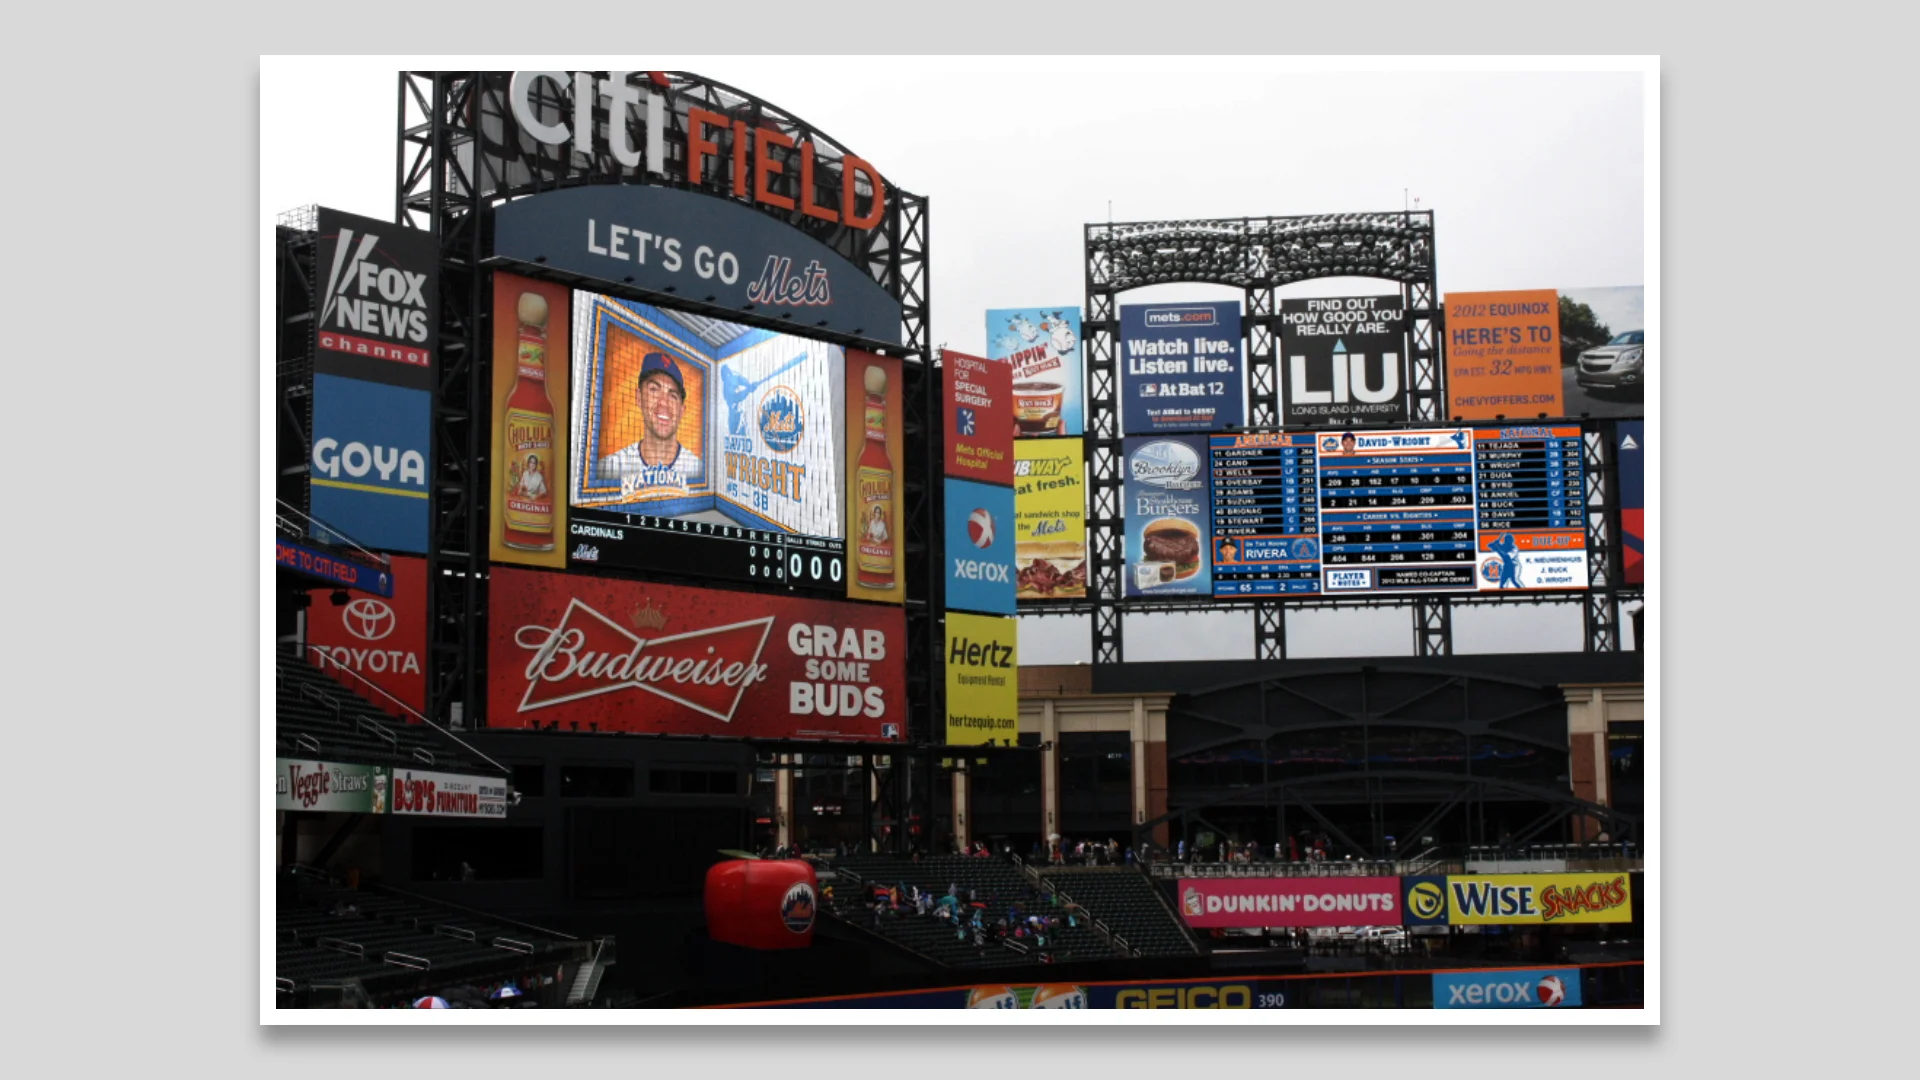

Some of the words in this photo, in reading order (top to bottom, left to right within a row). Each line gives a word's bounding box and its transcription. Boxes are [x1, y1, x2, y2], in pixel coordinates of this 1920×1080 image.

[509, 71, 664, 174] citi
[688, 106, 885, 231] FIELD
[588, 218, 683, 272] LET'S
[694, 245, 740, 285] GO
[747, 254, 834, 307] Mets
[358, 261, 427, 309] FOX
[1308, 300, 1341, 311] FIND
[1348, 298, 1378, 310] OUT
[1453, 304, 1486, 317] 2012
[1489, 303, 1550, 316] EQUINOX
[337, 295, 428, 343] NEWS
[1149, 311, 1212, 323] mets.com
[1282, 312, 1318, 325] HOW
[1323, 311, 1367, 323] GOOD
[1371, 309, 1404, 322] YOU
[1296, 323, 1353, 336] REALLY
[1356, 321, 1391, 334] ARE.
[1452, 327, 1522, 345] HERE'S
[1526, 325, 1553, 343] TO
[321, 336, 430, 365] channel
[1128, 339, 1189, 356] Watch
[1193, 336, 1235, 355] live.
[1453, 347, 1485, 358] Going
[1487, 346, 1504, 355] the
[1506, 345, 1552, 355] distance
[954, 358, 988, 374] HOSPITAL
[1129, 356, 1188, 375] Listen
[1193, 354, 1234, 373] live.
[1489, 359, 1514, 376] 32
[954, 369, 970, 381] FOR
[955, 380, 988, 396] SPECIAL
[1158, 383, 1177, 397] At
[1179, 382, 1205, 396] Bat
[1208, 382, 1224, 395] 12
[955, 391, 992, 408] SURGERY
[1455, 394, 1555, 407] CHEVYOFFERS.COM
[1291, 406, 1317, 415] LONG
[1319, 405, 1349, 414] ISLAND
[1350, 404, 1400, 413] UNIVERSITY
[1234, 435, 1293, 448] AMERICAN
[1500, 427, 1556, 440] NATIONAL
[723, 436, 753, 454] DAVID
[956, 443, 975, 456] Mets
[976, 447, 1004, 460] Official
[312, 436, 425, 485] GOYA
[956, 455, 988, 469] Hospital
[724, 450, 807, 503] WRIGHT
[1134, 461, 1193, 479] Brooklyn
[1037, 476, 1080, 491] fresh.
[510, 501, 549, 513] ORIGINAL
[753, 491, 769, 511] 3B
[1136, 497, 1200, 516] Burgers
[1024, 510, 1059, 519] sandwich
[1062, 511, 1080, 519] shop
[626, 514, 631, 524] 1
[640, 515, 647, 526] 2
[653, 517, 660, 528] 3
[668, 521, 675, 530] 4
[682, 521, 689, 532] 5
[696, 523, 702, 533] 6
[710, 524, 716, 534] 7
[723, 527, 729, 537] 8
[736, 528, 743, 538] 9
[750, 531, 757, 541] R
[763, 533, 771, 543] H
[777, 535, 783, 544] E
[570, 524, 624, 540] CARDINALS
[749, 545, 757, 558] 0
[762, 547, 770, 560] 0
[776, 549, 783, 561] 0
[789, 553, 803, 578] 0
[810, 556, 823, 580] 0
[829, 558, 842, 583] 0
[1246, 549, 1288, 559] RIVERA
[299, 551, 313, 570] TO
[314, 557, 331, 575] CITI
[333, 562, 357, 583] FIELD
[749, 563, 757, 577] 0
[762, 566, 770, 578] 0
[776, 567, 783, 579] 0
[954, 558, 1009, 583] xerox
[1333, 572, 1365, 580] PLAYER
[1240, 583, 1252, 592] 65
[1280, 583, 1286, 591] 2
[1312, 582, 1319, 591] 3
[788, 624, 885, 661] GRAB
[317, 645, 420, 675] TOYOTA
[515, 625, 767, 688] Budweiser
[950, 636, 1013, 668] Hertz
[805, 659, 870, 683] SOME
[789, 681, 885, 718] BUDS
[949, 714, 1015, 731] hertzequip.com
[290, 764, 330, 808] Veggie
[332, 769, 368, 793] Straws
[436, 792, 478, 814] FURNITURE
[1206, 893, 1300, 913] DUNKIN'
[1303, 893, 1394, 911] DONUTS
[1451, 881, 1538, 916] WISE
[1540, 876, 1628, 921] SNACKS
[1115, 985, 1251, 1009] GEICO
[1258, 994, 1285, 1007] 390
[1448, 981, 1532, 1004] xerox
